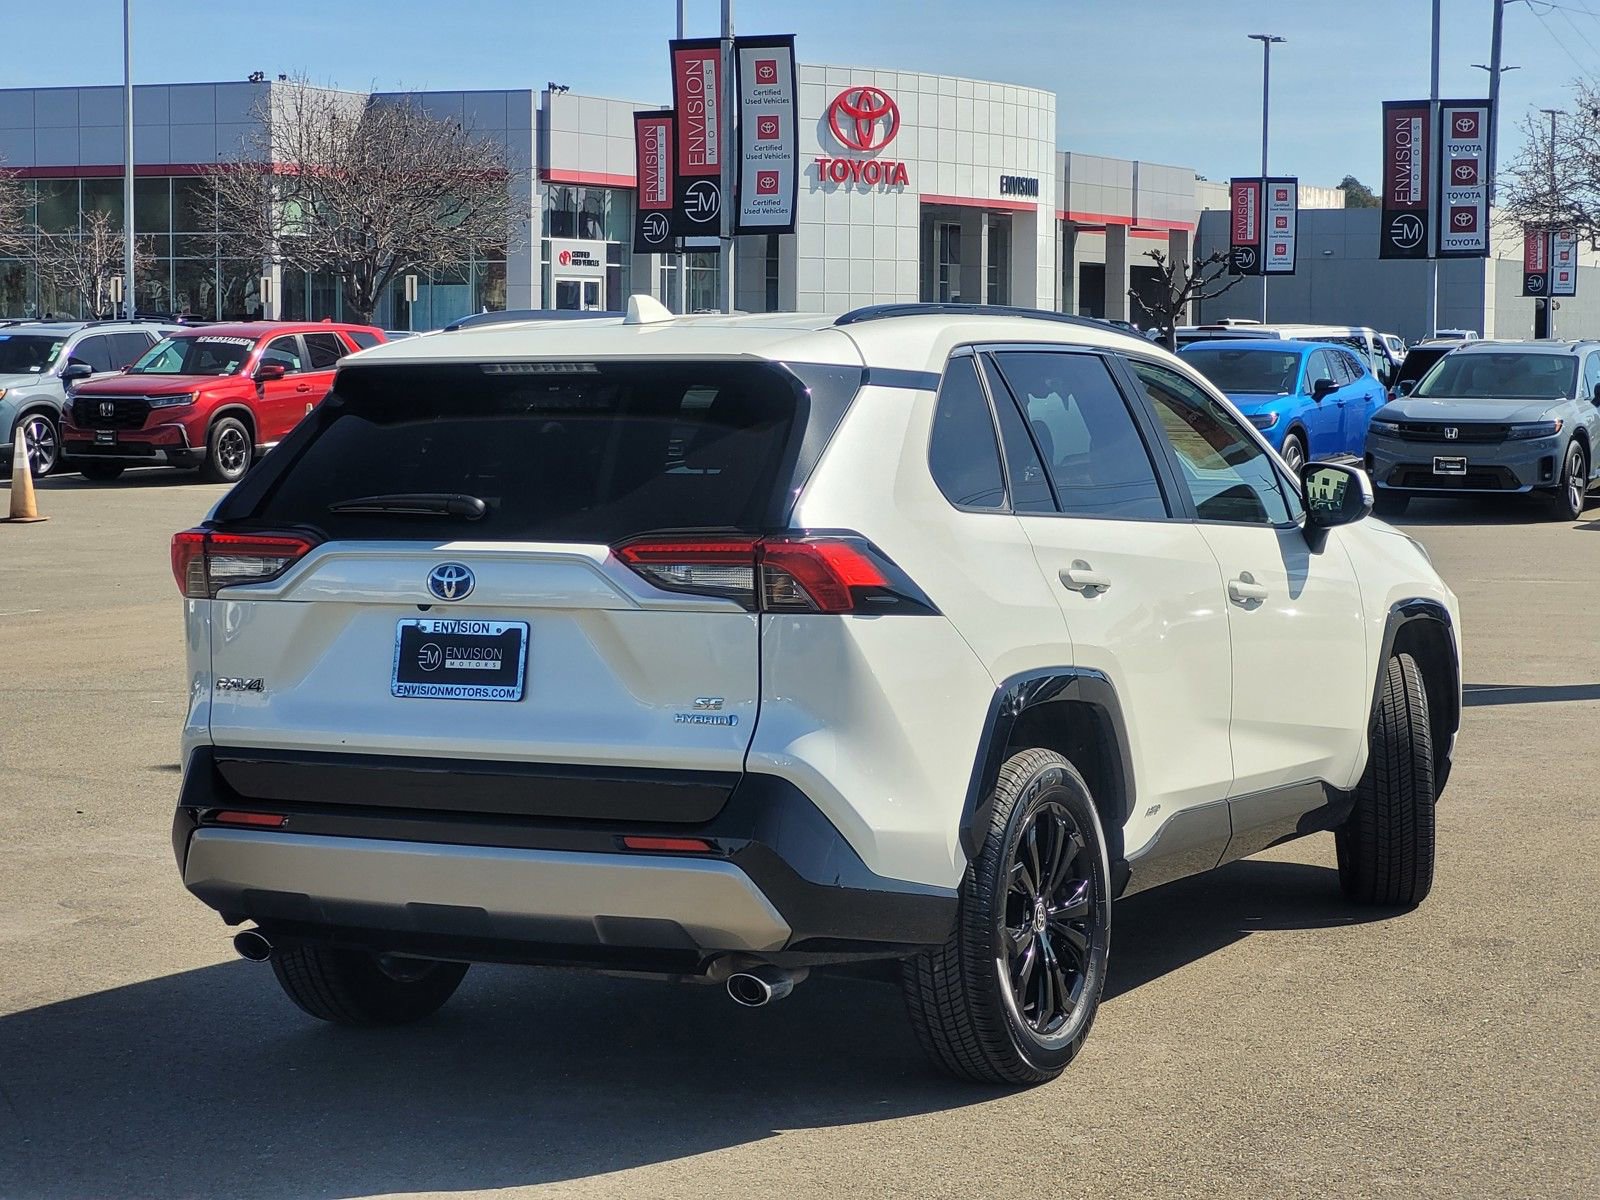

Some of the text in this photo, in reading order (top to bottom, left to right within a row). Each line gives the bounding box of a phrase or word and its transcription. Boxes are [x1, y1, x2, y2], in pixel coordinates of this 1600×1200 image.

[685, 59, 704, 166] ENVISION
[706, 69, 715, 156] MOTORS
[763, 152, 791, 160] Vehicles
[1395, 118, 1410, 202] ENVISION
[1447, 144, 1482, 152] TOYOTA
[645, 125, 658, 203] ENVISION
[815, 157, 910, 186] TOYOTA
[1000, 175, 1039, 196] ENVISION
[1238, 187, 1247, 240] ENVISION
[433, 622, 490, 634] ENVISION
[446, 647, 503, 660] ENVISION
[396, 684, 515, 699] ENVISIONMOTORS.COM
